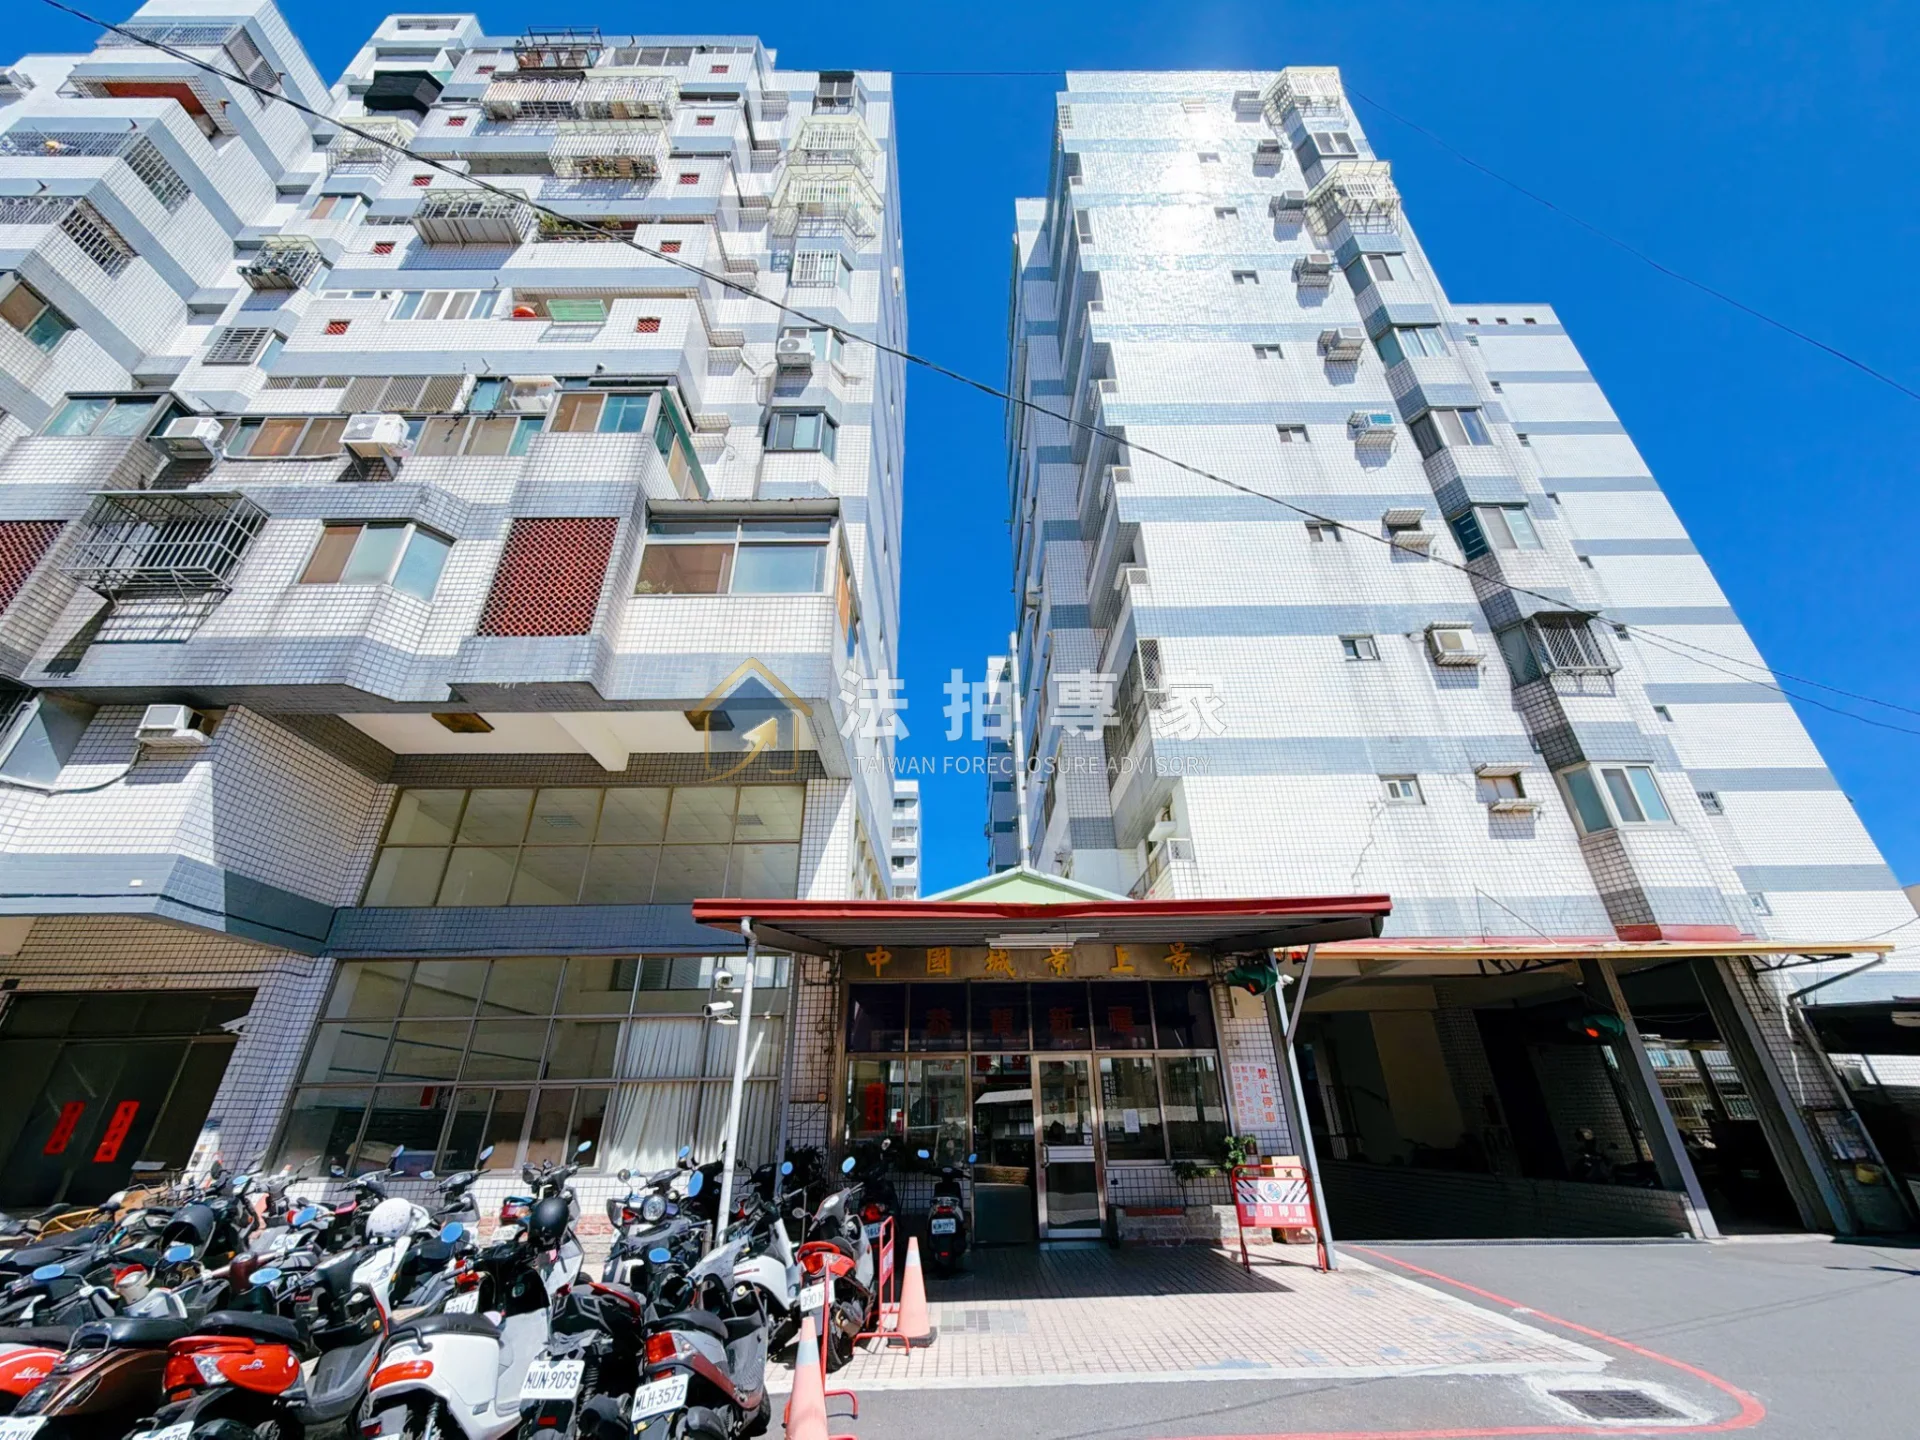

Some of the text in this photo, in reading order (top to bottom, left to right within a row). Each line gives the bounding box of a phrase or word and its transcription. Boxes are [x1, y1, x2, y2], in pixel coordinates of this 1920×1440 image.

[866, 942, 1191, 977] 中國城景上景
[1257, 1067, 1276, 1123] 禁止停車
[524, 1371, 579, 1389] NUN-9093
[634, 1384, 684, 1413] MLH-3572
